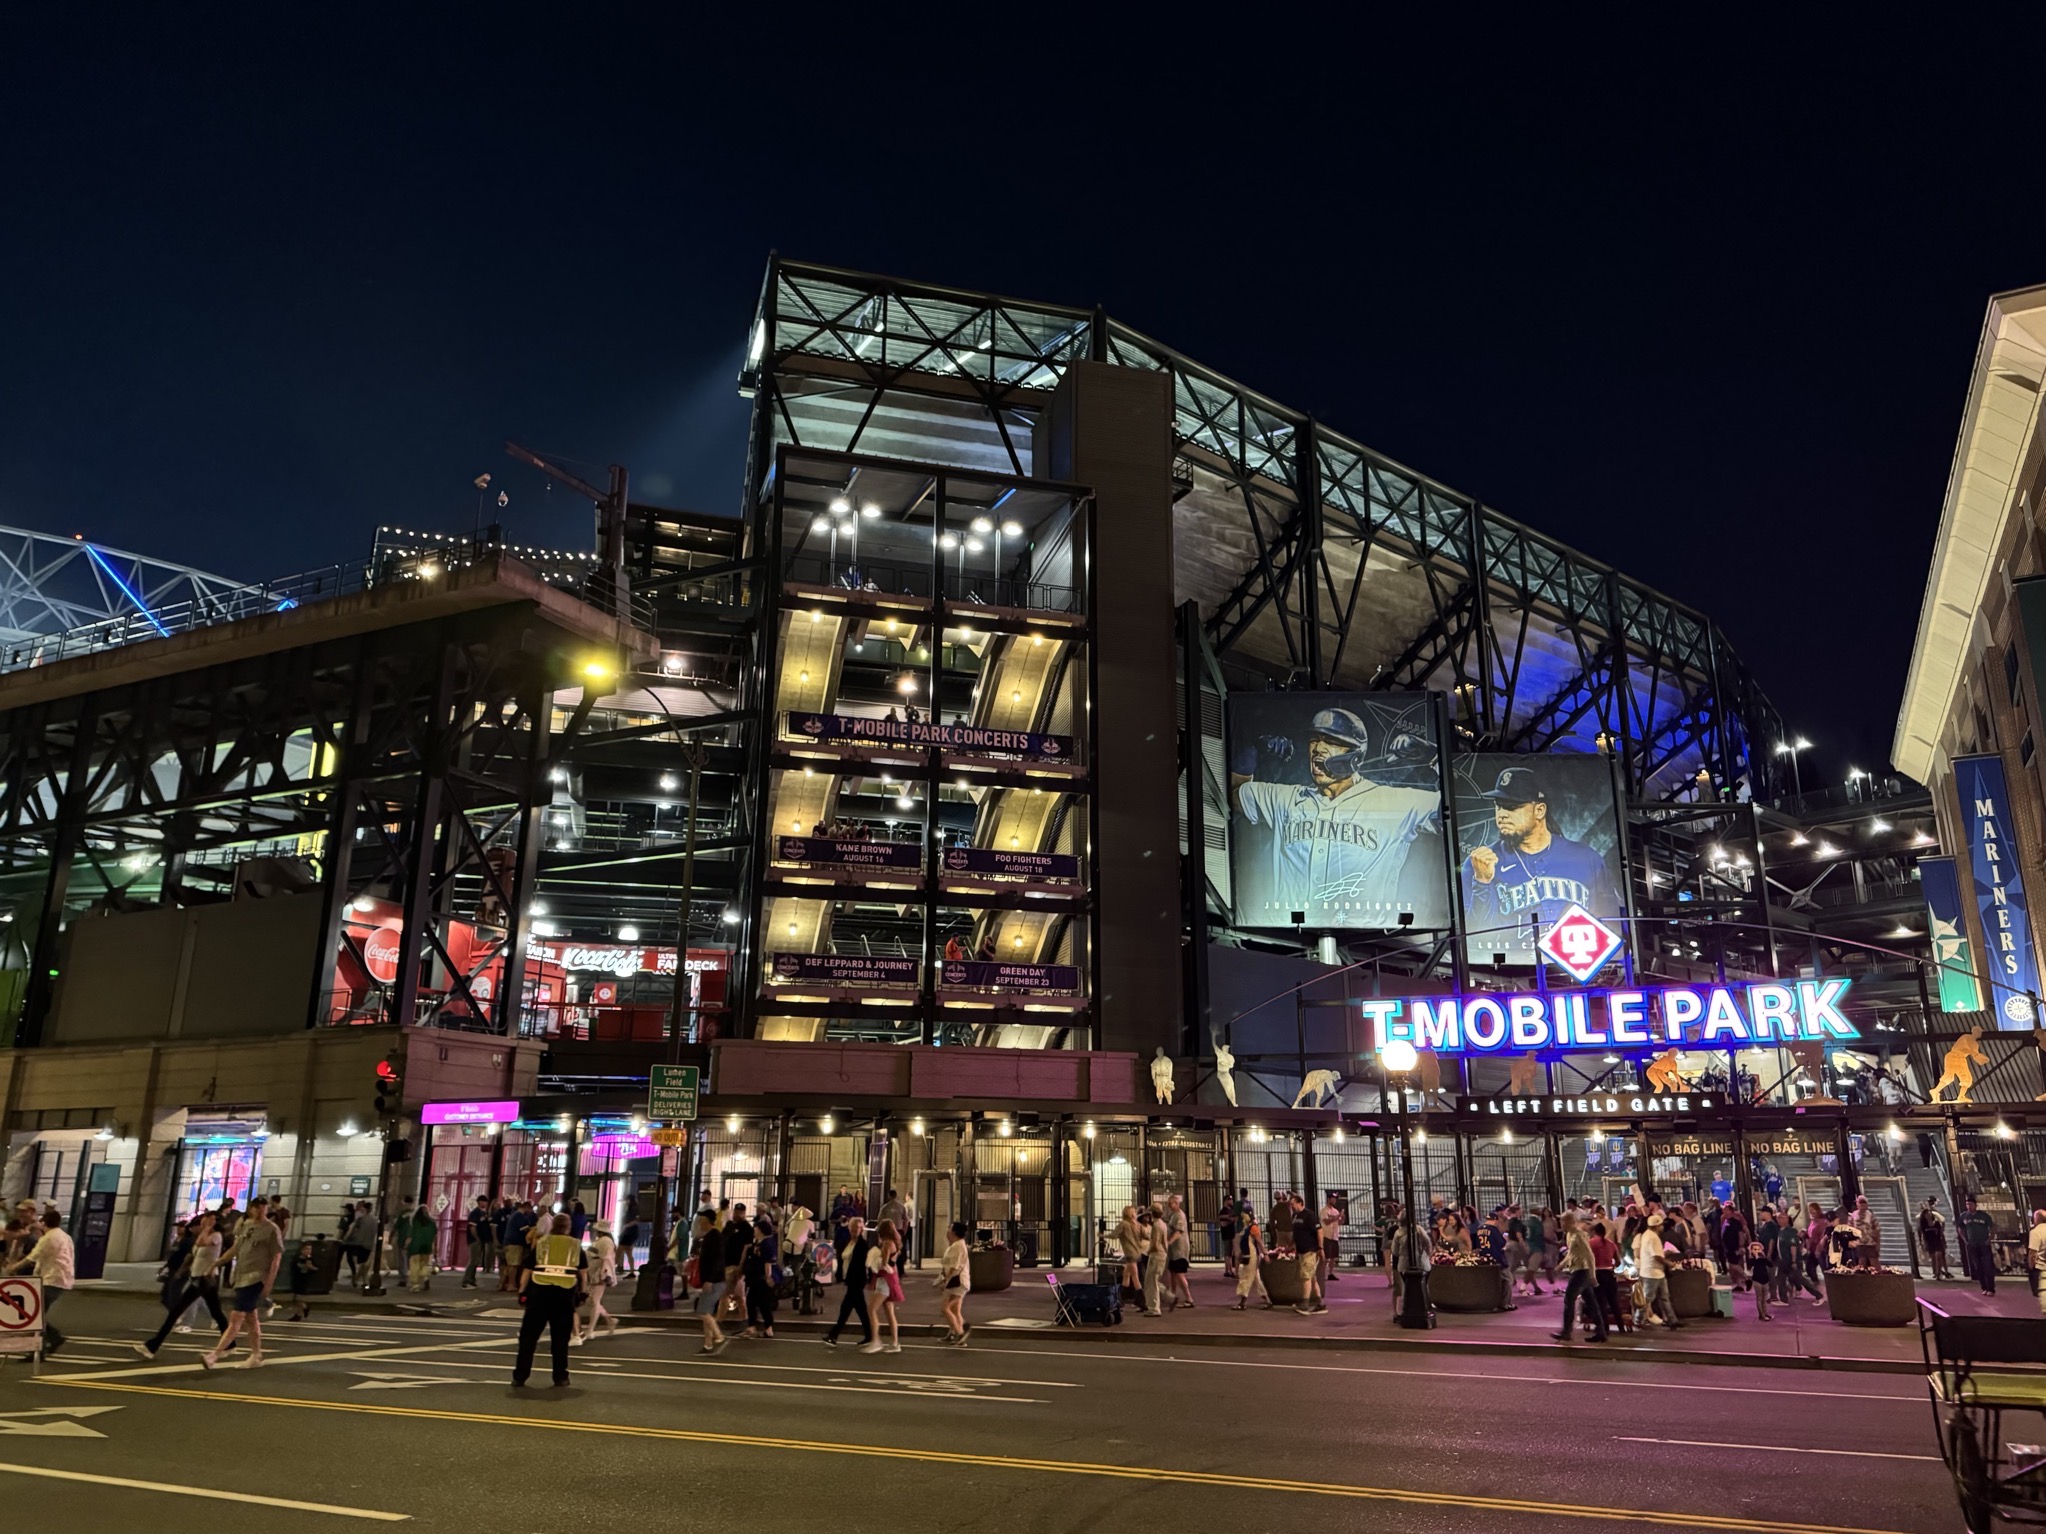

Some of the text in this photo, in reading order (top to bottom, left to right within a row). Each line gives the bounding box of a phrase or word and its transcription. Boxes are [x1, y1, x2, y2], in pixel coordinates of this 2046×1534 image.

[838, 718, 908, 739] T-MOBILE
[912, 724, 951, 743] PARK
[953, 728, 1028, 750] CONCERTS
[1284, 818, 1379, 852] MARINERS
[836, 843, 892, 855] KANE BROWN
[843, 854, 873, 863] AUGUST
[995, 854, 1052, 865] FOO FIGHTERS
[1004, 864, 1033, 873] AUGUST
[1975, 799, 2018, 976] MARINERS
[1496, 876, 1590, 916] SEATTLE
[1265, 900, 1310, 910] JULIO
[1478, 941, 1510, 950] LUIS
[561, 947, 644, 978] Coca-Cola
[685, 960, 719, 971] DECK
[805, 958, 914, 970] DEF LEPPARD & JOURNEY
[832, 969, 886, 979] SEPTEMBER 4
[1000, 966, 1046, 977] GREEN DAY
[995, 976, 1050, 986] SEPTEMBER 23
[1363, 980, 1858, 1051] T-MOBILE PARK
[665, 1077, 683, 1087] Field
[653, 1090, 694, 1099] T-Mobile Park
[653, 1101, 692, 1109] DELIVERIES
[1489, 1098, 1691, 1114] LEFT FIELD GATE
[674, 1109, 692, 1117] LANE
[1652, 1142, 1733, 1155] NO BAG LINE
[1750, 1141, 1836, 1154] NO BAG LINE
